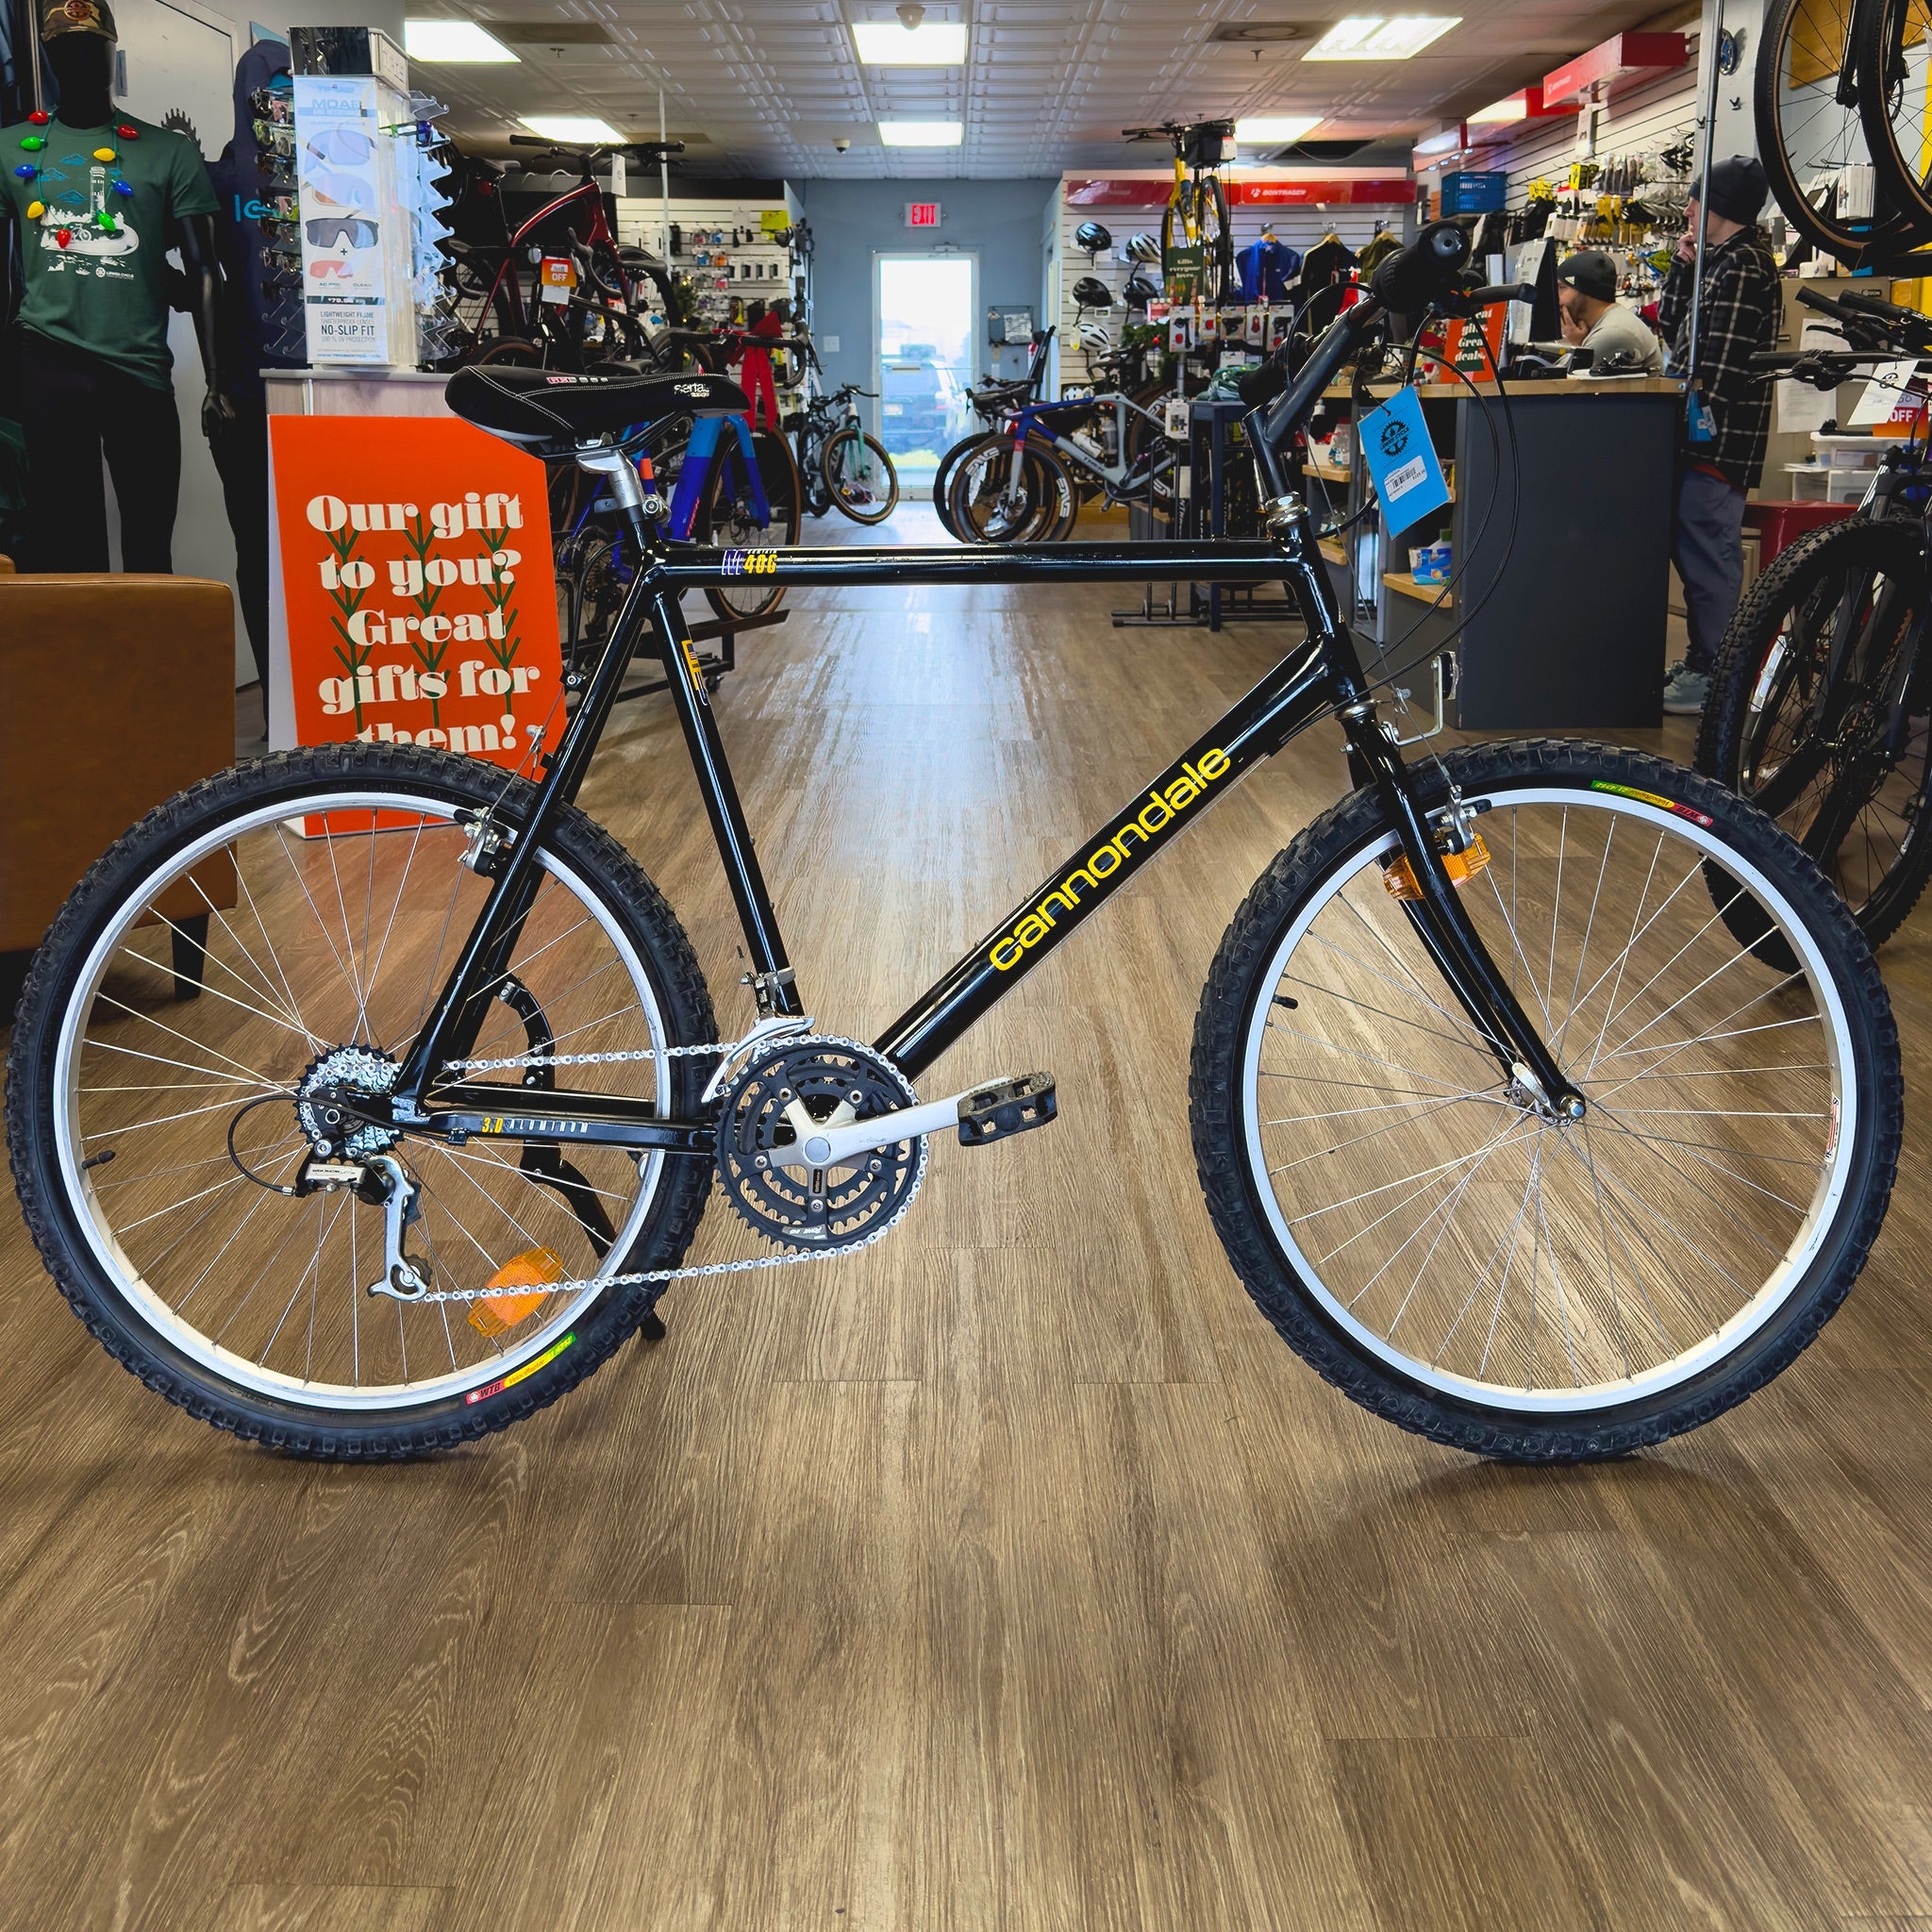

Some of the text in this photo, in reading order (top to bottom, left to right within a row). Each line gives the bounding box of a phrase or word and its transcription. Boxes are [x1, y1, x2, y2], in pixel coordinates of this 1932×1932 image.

[911, 204, 936, 225] EXIT
[552, 273, 567, 282] OFF
[321, 325, 375, 336] NO-SLIP FIT
[1457, 338, 1485, 348] Grea
[1454, 350, 1487, 361] deals.
[1890, 409, 1914, 423] OFF
[306, 491, 524, 539] Our gift
[317, 548, 523, 597] to you?
[742, 554, 778, 575] 406
[346, 604, 508, 647] Great
[318, 659, 541, 716] gifts for
[354, 713, 518, 754] them!
[989, 747, 1231, 972] cannondale
[481, 1117, 589, 1134] 3.0 ALUMINUM
[479, 1382, 501, 1398] WTB
